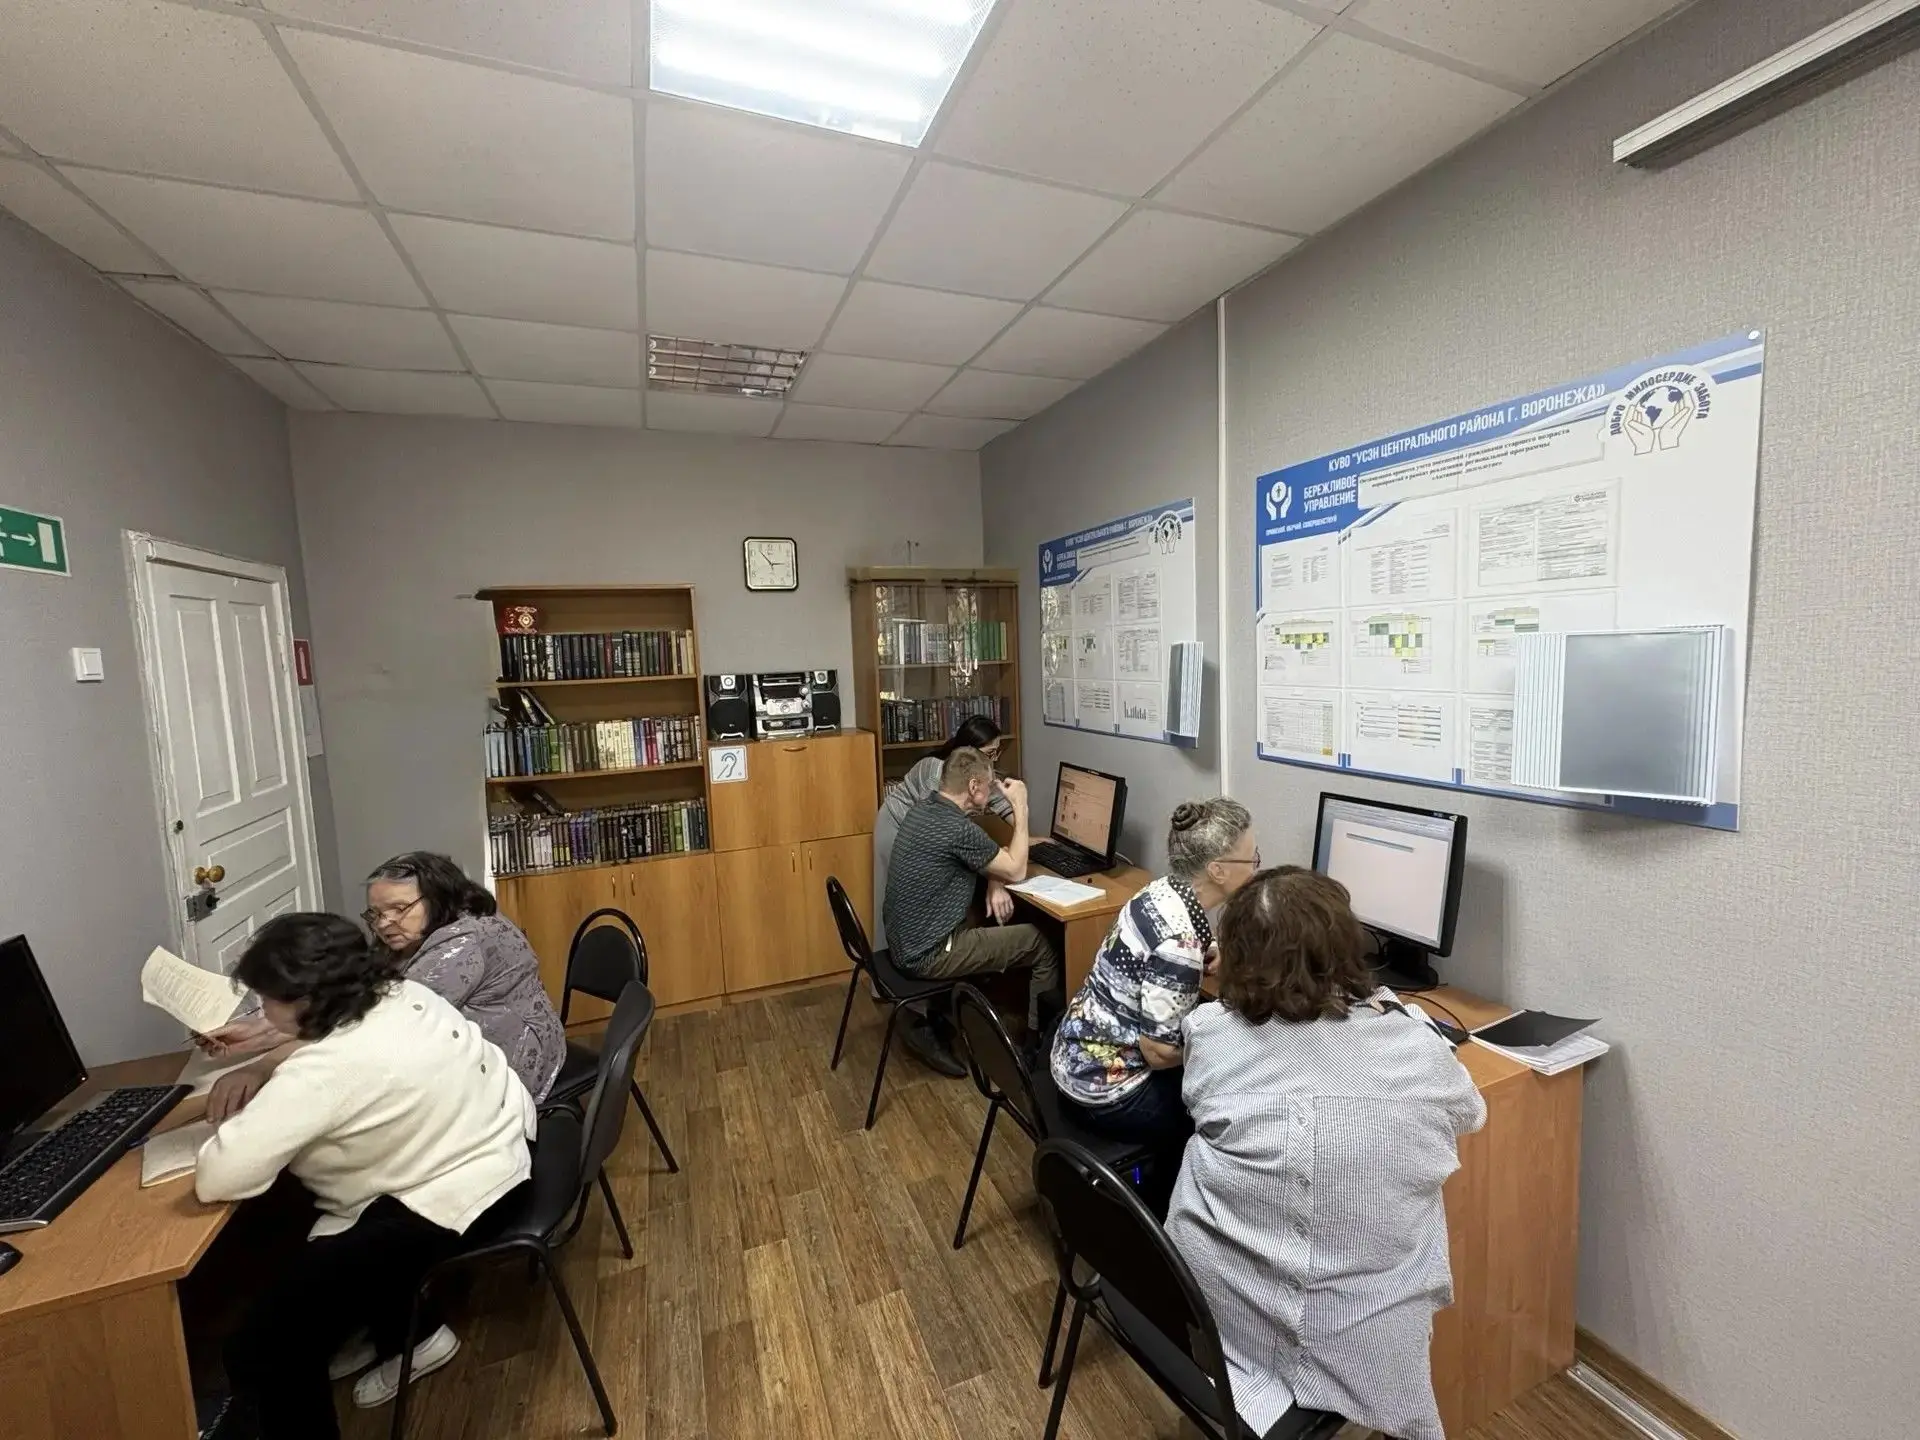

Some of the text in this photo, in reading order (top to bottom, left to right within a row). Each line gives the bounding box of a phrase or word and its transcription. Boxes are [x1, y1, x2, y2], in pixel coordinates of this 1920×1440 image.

[1610, 372, 1711, 436] ДОБРО МИЛОСЕРДИЕ ЗАБОТА
[1328, 454, 1351, 472] КУВО
[1380, 423, 1457, 458] ЦЕНТРАЛЬНОГО
[1459, 411, 1505, 437] РАЙОНА
[1507, 407, 1518, 423] Г.
[1521, 384, 1606, 419] ВОРОНЕЖА»
[1303, 474, 1357, 500] БЕРЕЖЛИВОЕ
[1303, 489, 1357, 513] УПРАВЛЕНИЕ
